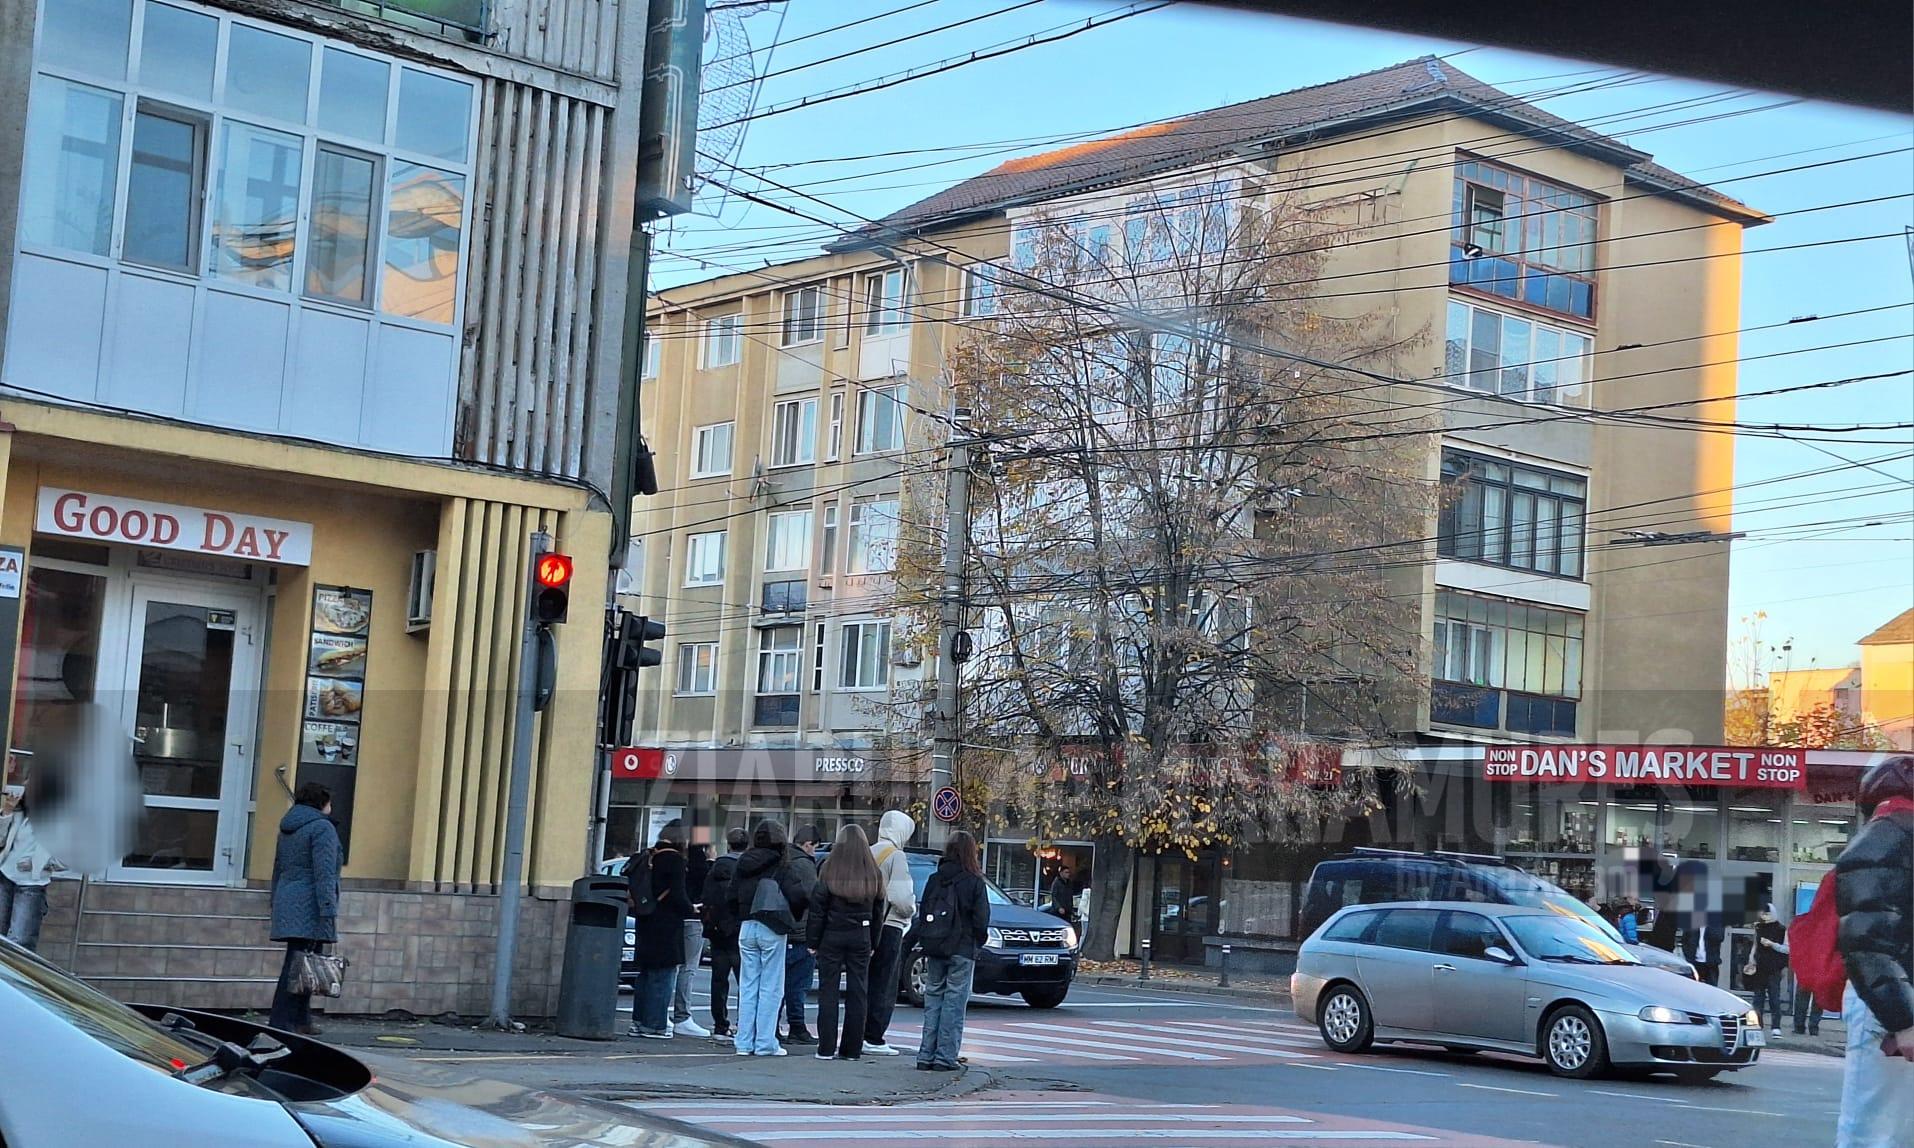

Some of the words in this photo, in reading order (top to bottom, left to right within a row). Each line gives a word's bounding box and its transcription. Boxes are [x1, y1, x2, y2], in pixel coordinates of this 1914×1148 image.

[53, 492, 180, 545] GOOD
[200, 512, 290, 560] DAY
[1489, 749, 1516, 762] NON
[1761, 753, 1797, 767] NON
[1486, 763, 1519, 776] STOP
[1520, 750, 1607, 777] DAN'S
[1615, 751, 1755, 780] MARKET
[1757, 768, 1800, 782] STOP
